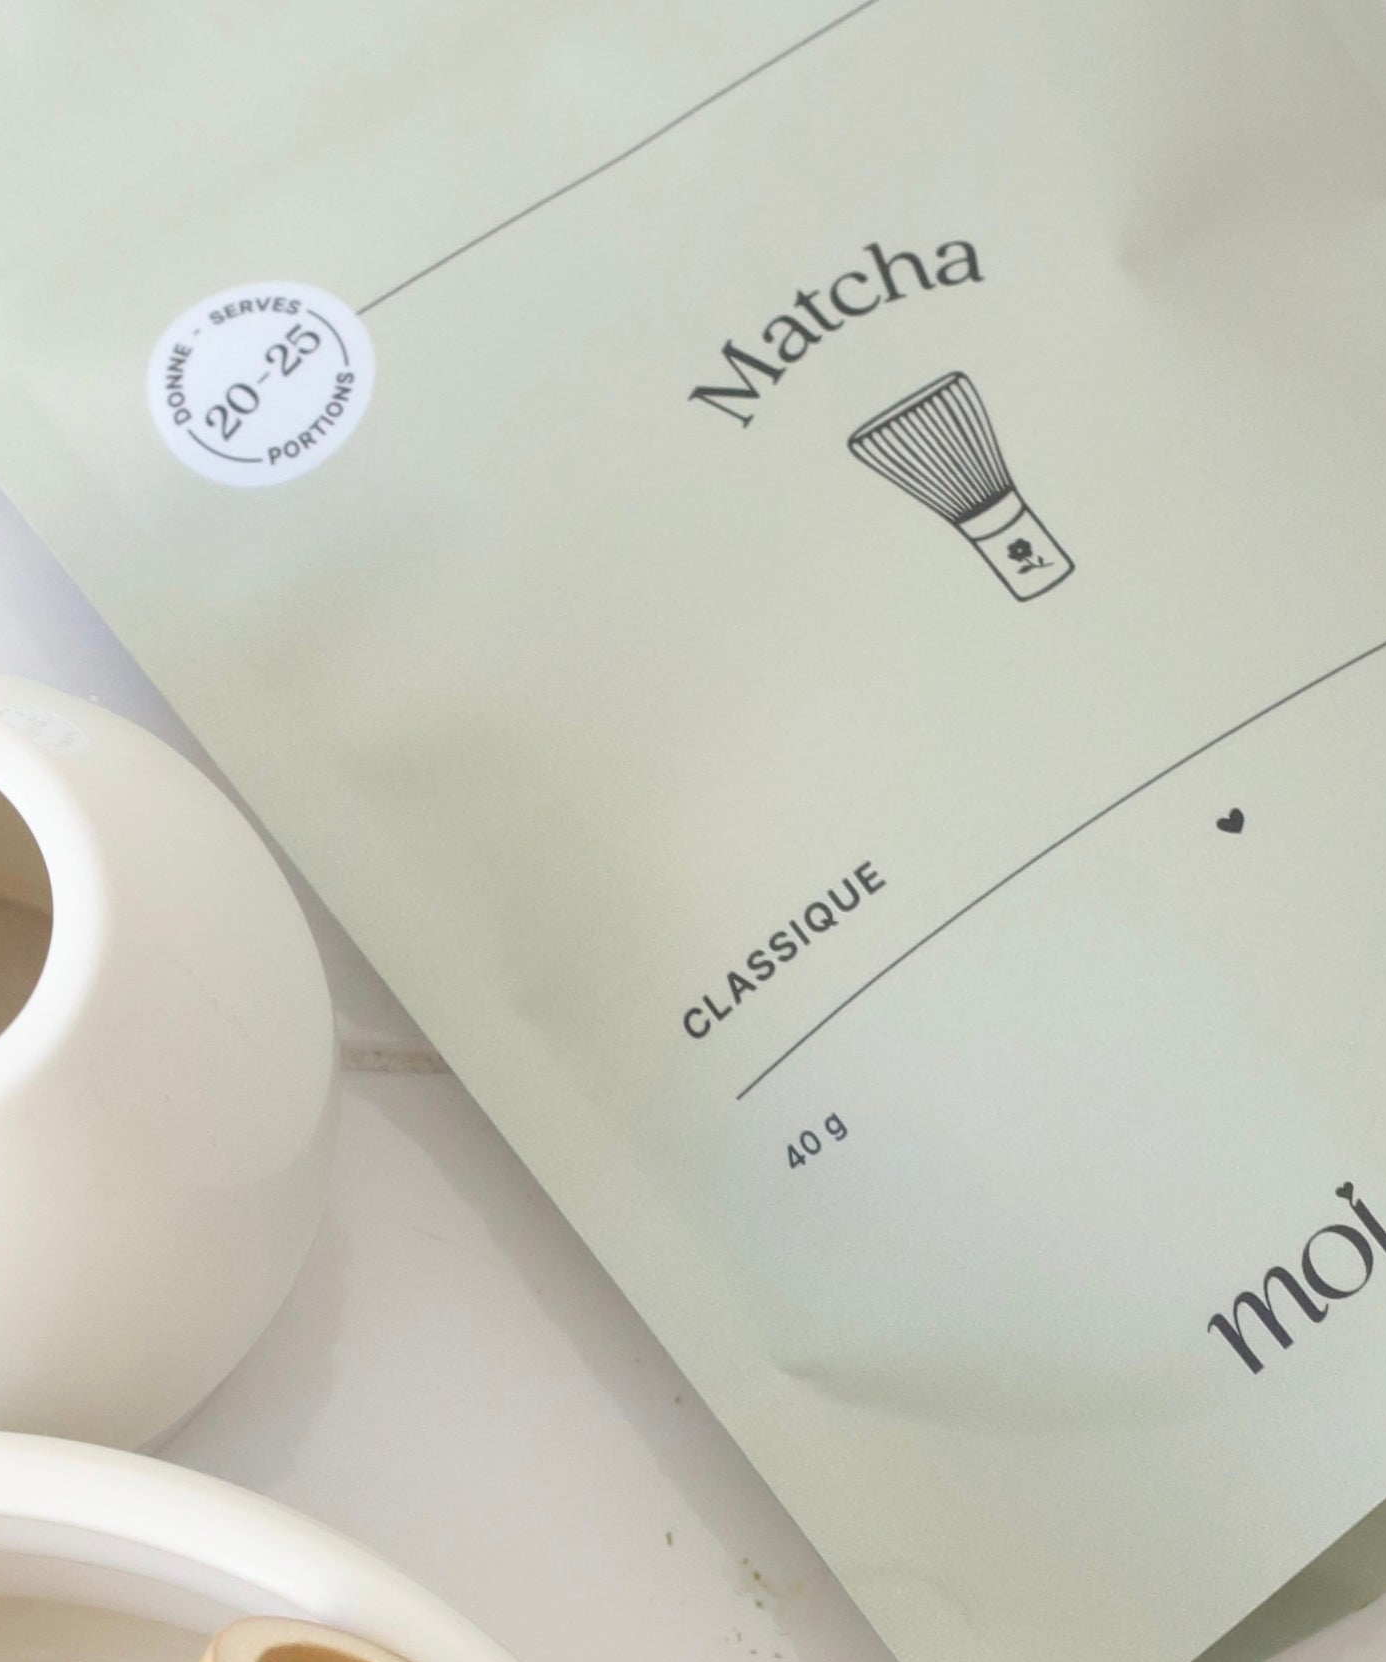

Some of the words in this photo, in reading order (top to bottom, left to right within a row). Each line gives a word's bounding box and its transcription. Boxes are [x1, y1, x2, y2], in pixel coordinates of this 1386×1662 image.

[165, 343, 192, 426] DONNE
[209, 297, 302, 325] SERVES
[688, 239, 984, 428] Matcha
[267, 371, 355, 465] PORTIONS
[683, 861, 887, 1039] CLASSIQUE
[786, 1130, 822, 1169] 40
[825, 1113, 848, 1141] g
